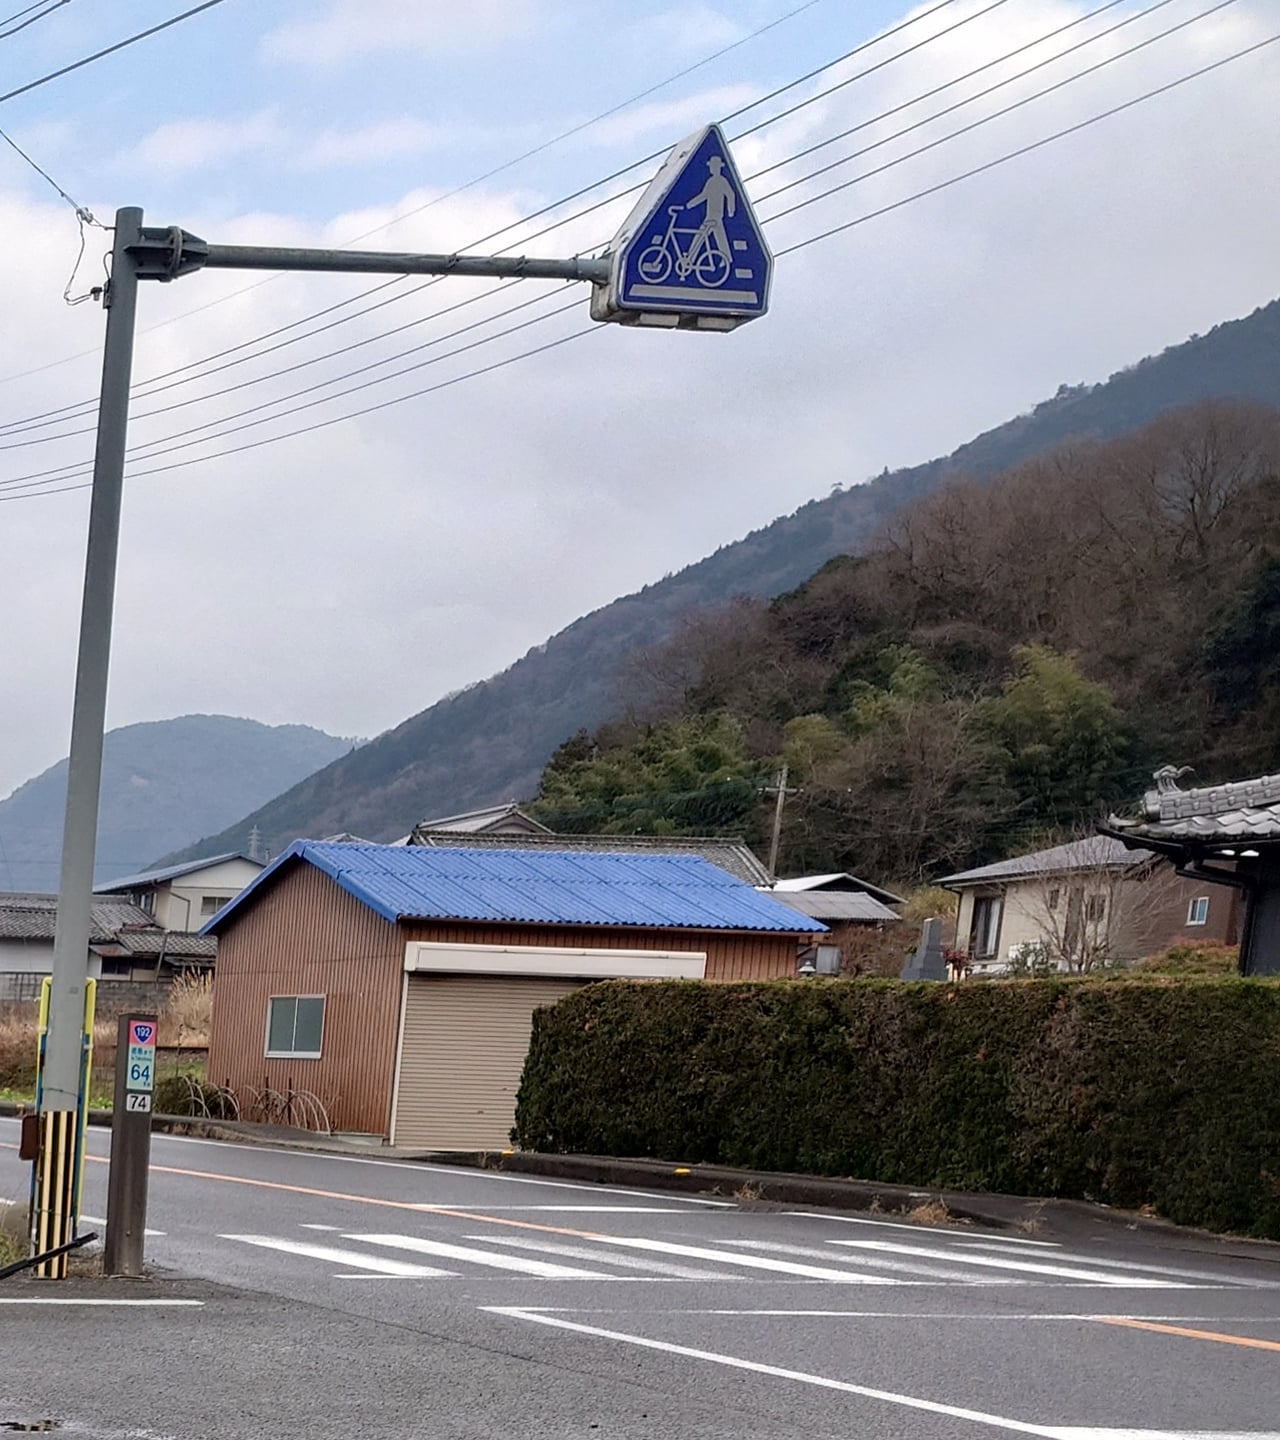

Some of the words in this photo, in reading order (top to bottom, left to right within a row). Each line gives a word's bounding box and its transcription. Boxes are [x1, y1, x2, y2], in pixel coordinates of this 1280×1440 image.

[136, 1026, 150, 1037] 192
[131, 1064, 150, 1081] 64
[130, 1095, 146, 1110] 74
